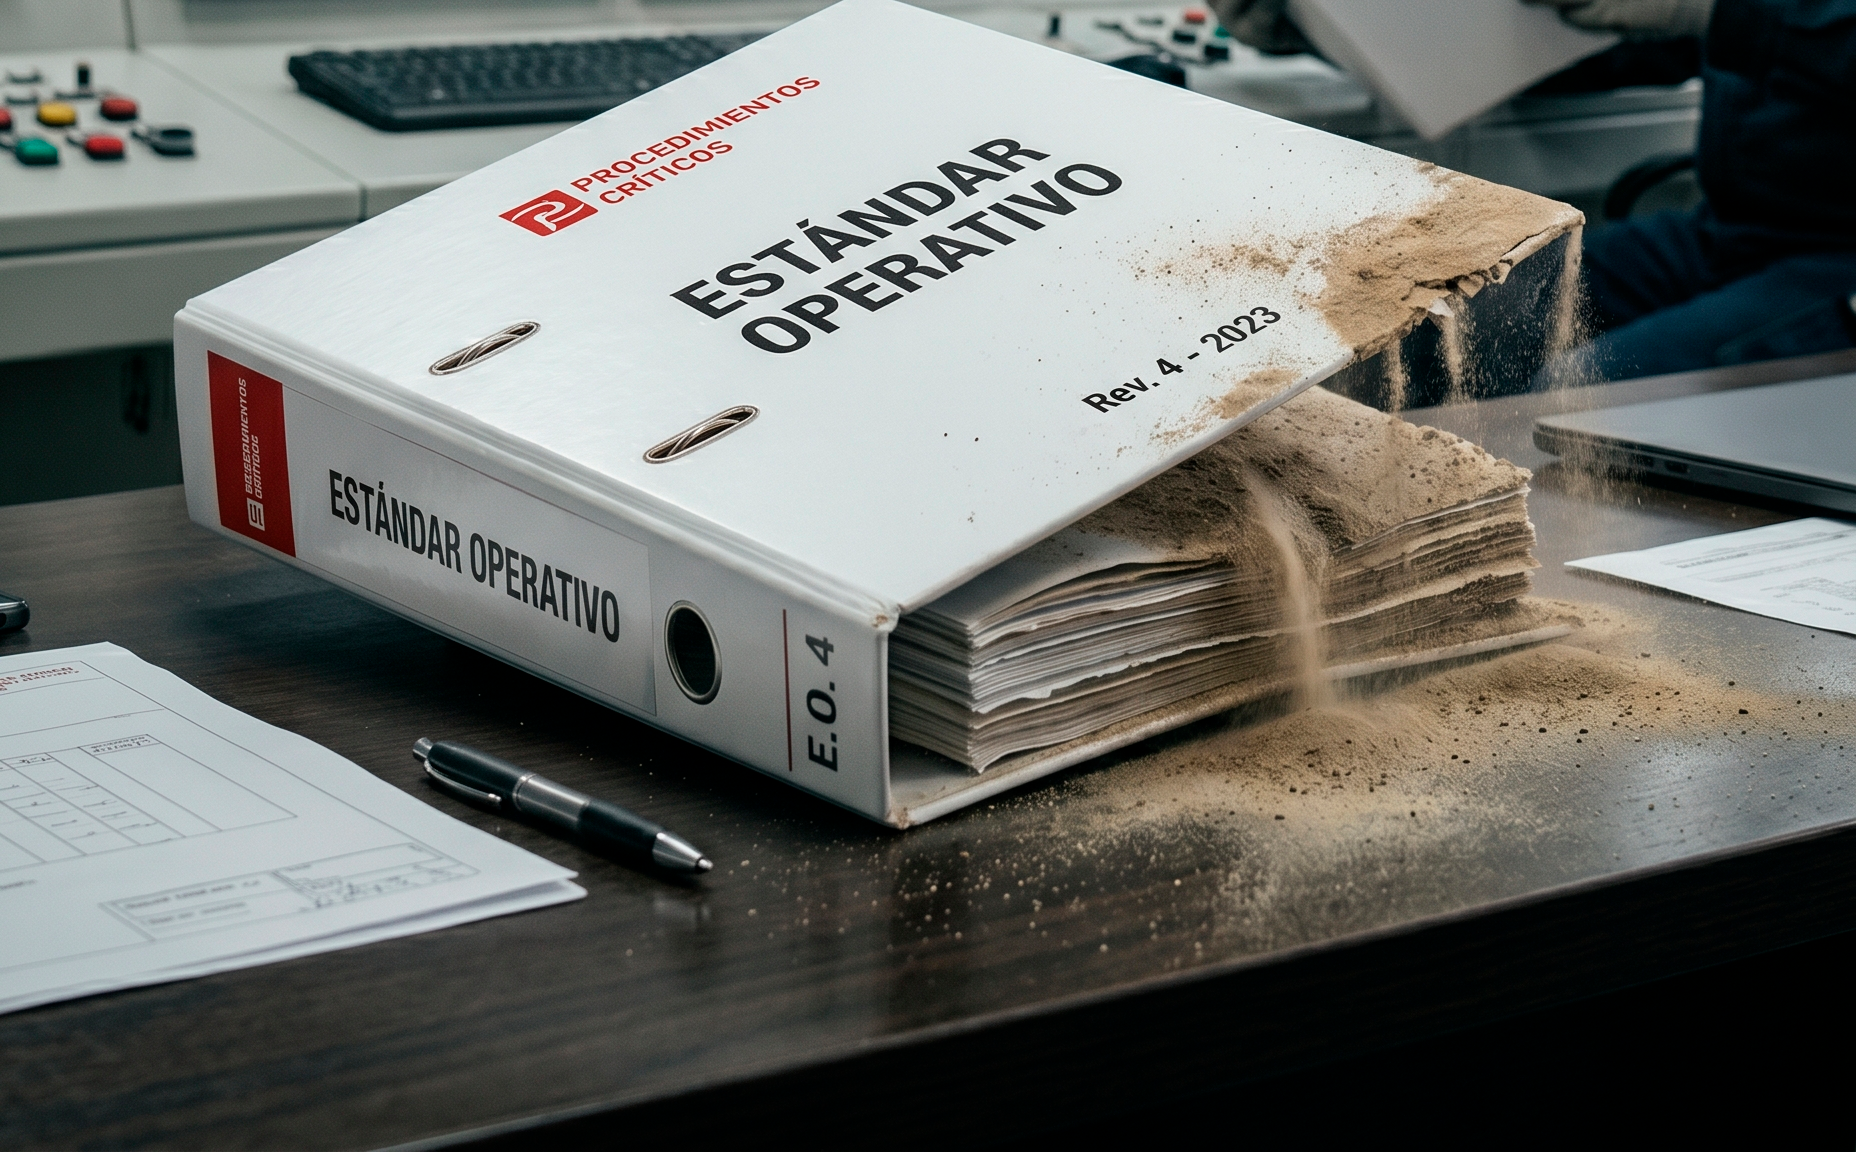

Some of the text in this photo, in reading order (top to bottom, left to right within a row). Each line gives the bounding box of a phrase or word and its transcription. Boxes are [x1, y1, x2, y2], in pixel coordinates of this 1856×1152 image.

[570, 76, 821, 193] PROCEDIMIENTOS
[599, 140, 734, 205] CRÍTICOS
[670, 138, 1051, 320] ESTÁNDAR
[741, 163, 1123, 354] OPERATIVO
[1081, 376, 1161, 414] Rev.
[1156, 357, 1184, 376] 4
[1200, 306, 1281, 354] 2023
[329, 468, 620, 643] ESTÁNDAR OPERATIVO
[805, 633, 835, 667] 4
